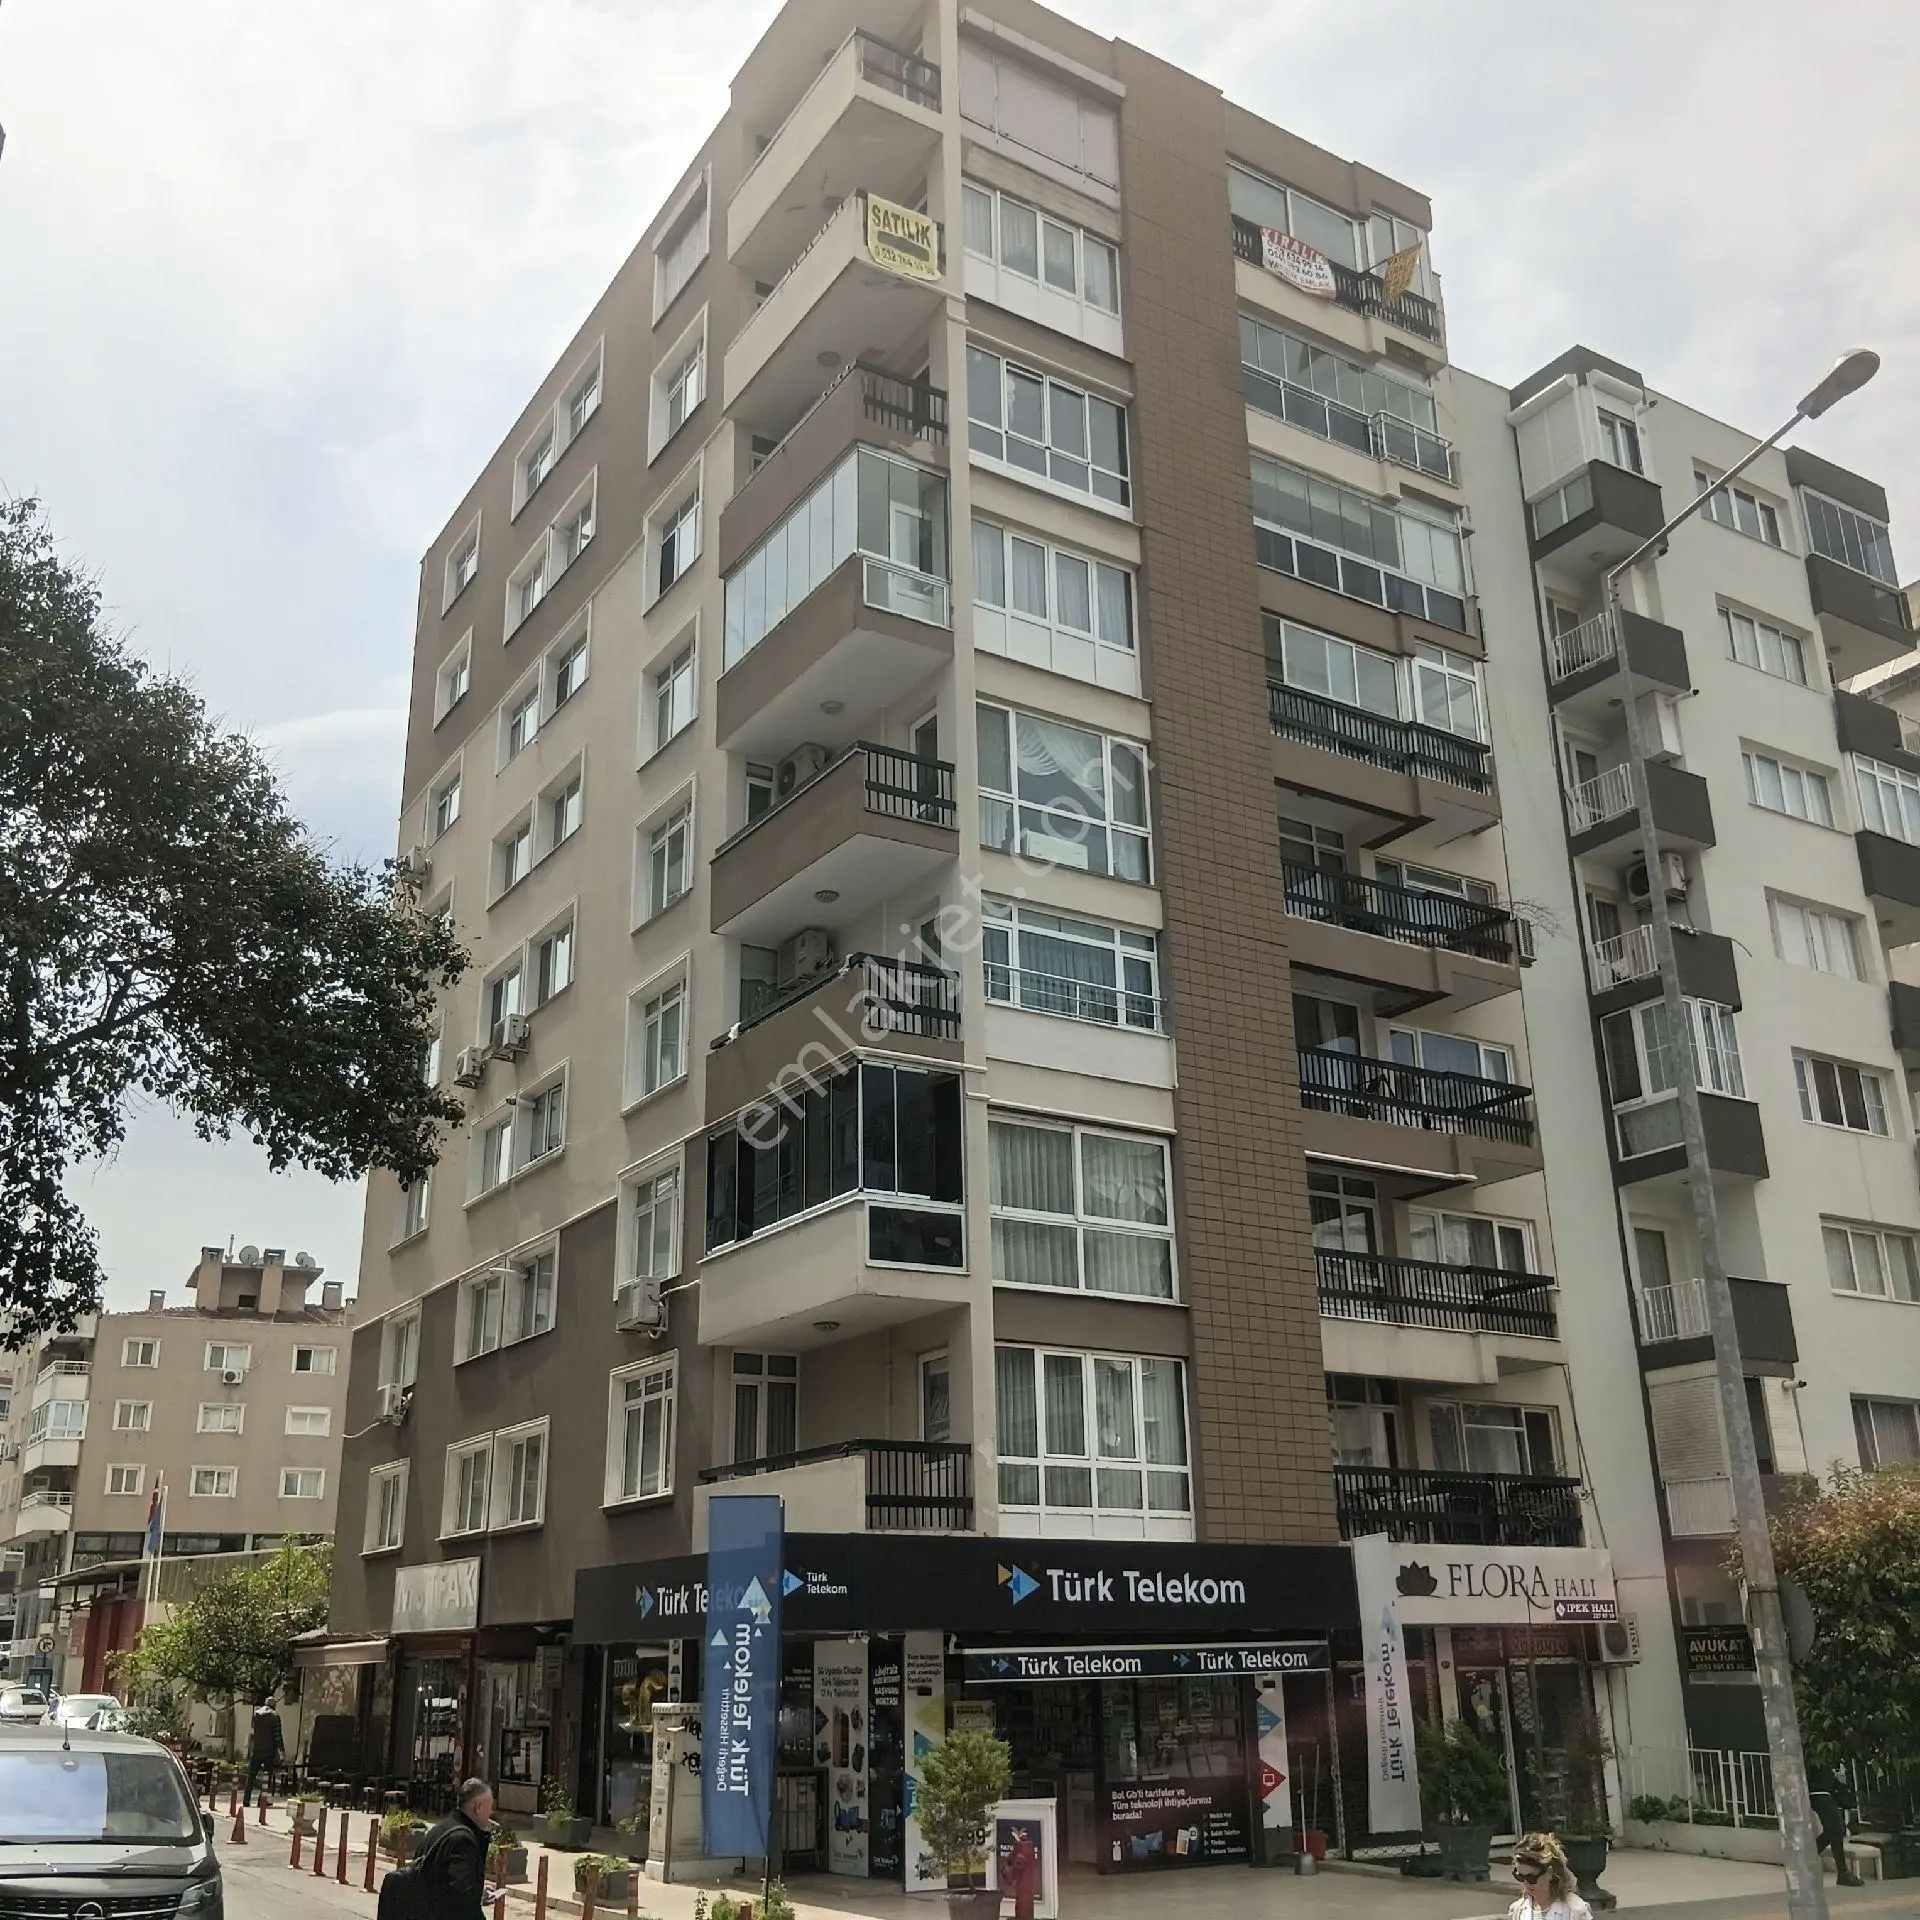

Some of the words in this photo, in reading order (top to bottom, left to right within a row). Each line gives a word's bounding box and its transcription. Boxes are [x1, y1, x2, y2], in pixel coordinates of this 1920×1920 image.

[806, 1572, 828, 1582] Türk
[1046, 1568, 1114, 1602] Türk
[1122, 1570, 1246, 1604] Telekom
[1446, 1563, 1550, 1609] FLORA
[1554, 1578, 1597, 1597] HALI
[807, 1584, 848, 1595] Telekom
[657, 1587, 689, 1616] Türk
[1591, 1603, 1615, 1613] HALI
[1689, 1639, 1746, 1653] AVUKAT
[1018, 1656, 1060, 1675] Türk
[1063, 1655, 1143, 1675] Telekom
[1197, 1651, 1234, 1670] Türk
[1238, 1649, 1308, 1668] Telekom
